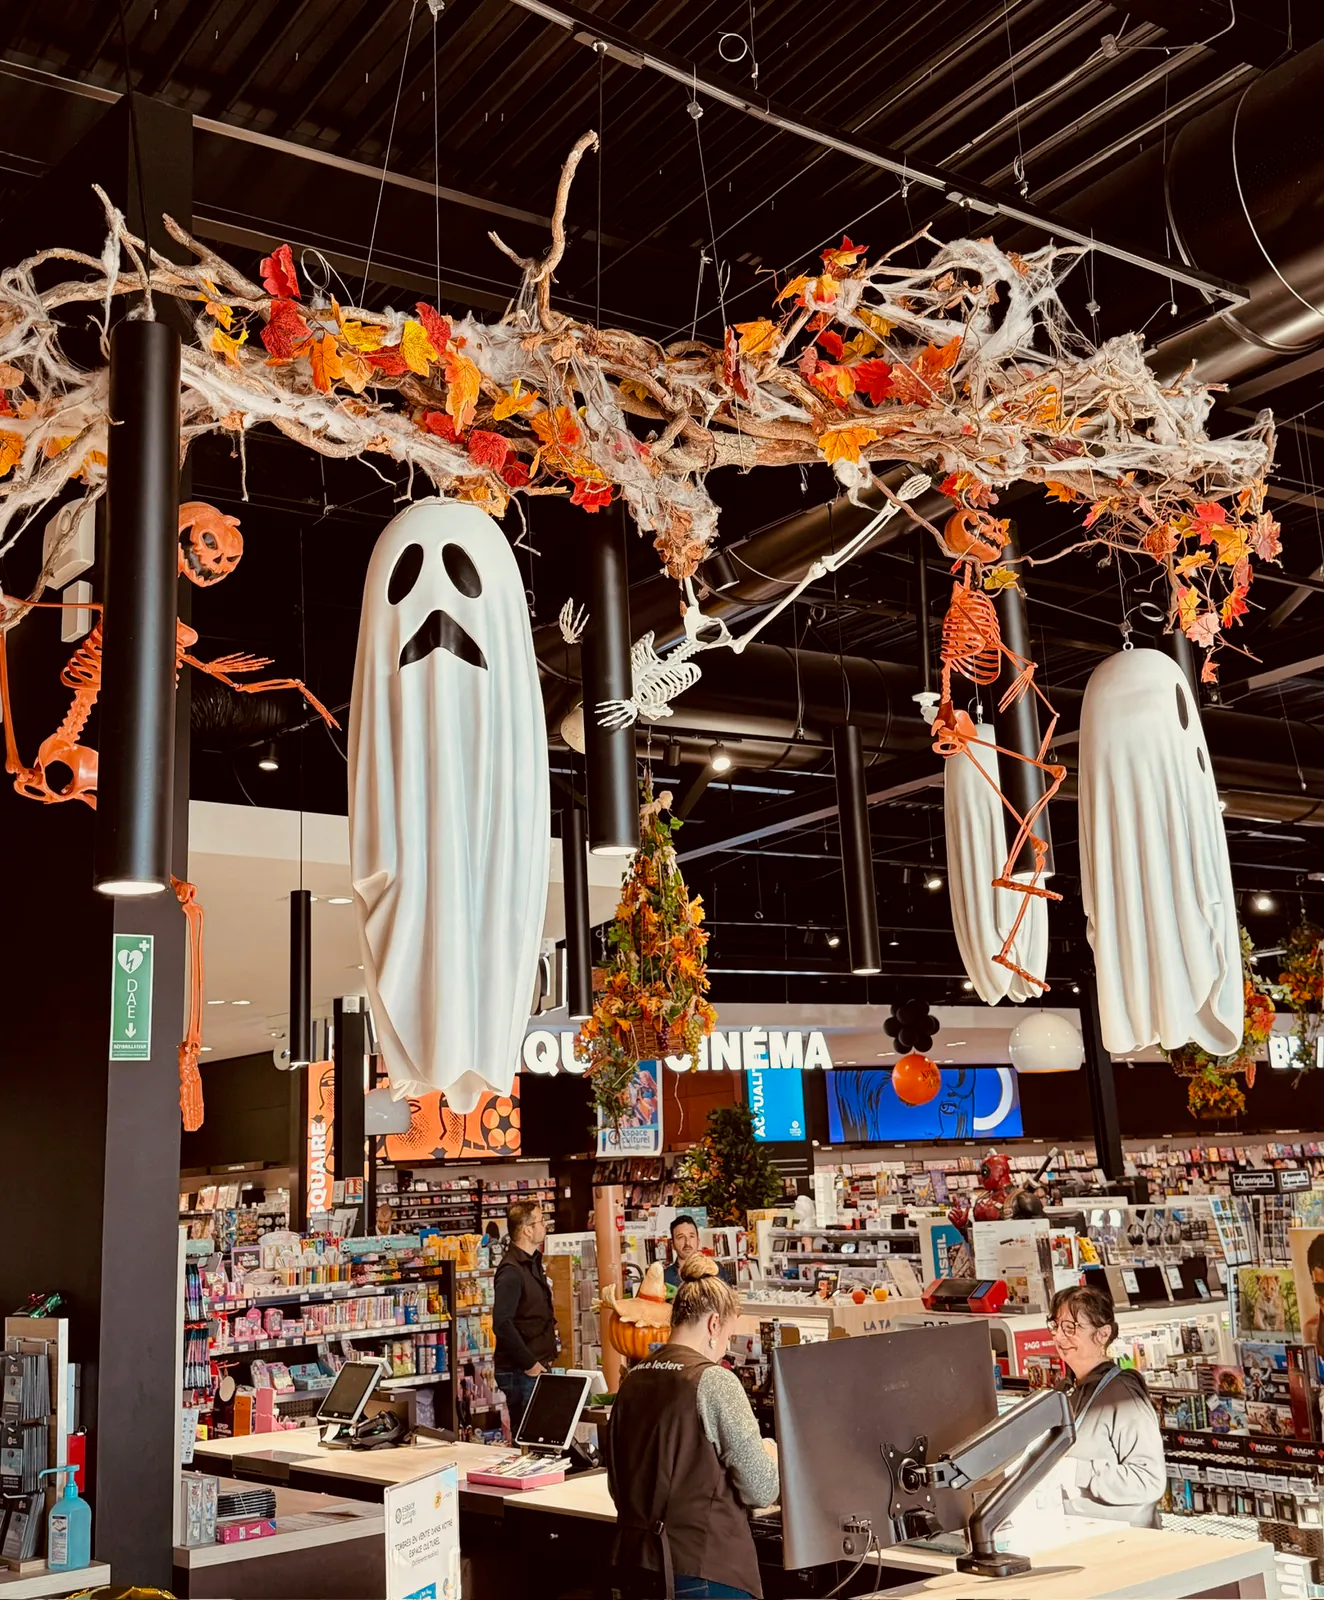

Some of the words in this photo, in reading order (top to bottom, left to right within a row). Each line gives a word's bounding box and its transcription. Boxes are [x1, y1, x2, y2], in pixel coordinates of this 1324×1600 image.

[126, 978, 138, 1019] DAE
[863, 1320, 877, 1332] LA
[1183, 1435, 1205, 1446] MAGIC
[1217, 1440, 1240, 1449] MAGIC
[1255, 1443, 1278, 1453] MAGIC
[1292, 1447, 1316, 1456] MAGIC
